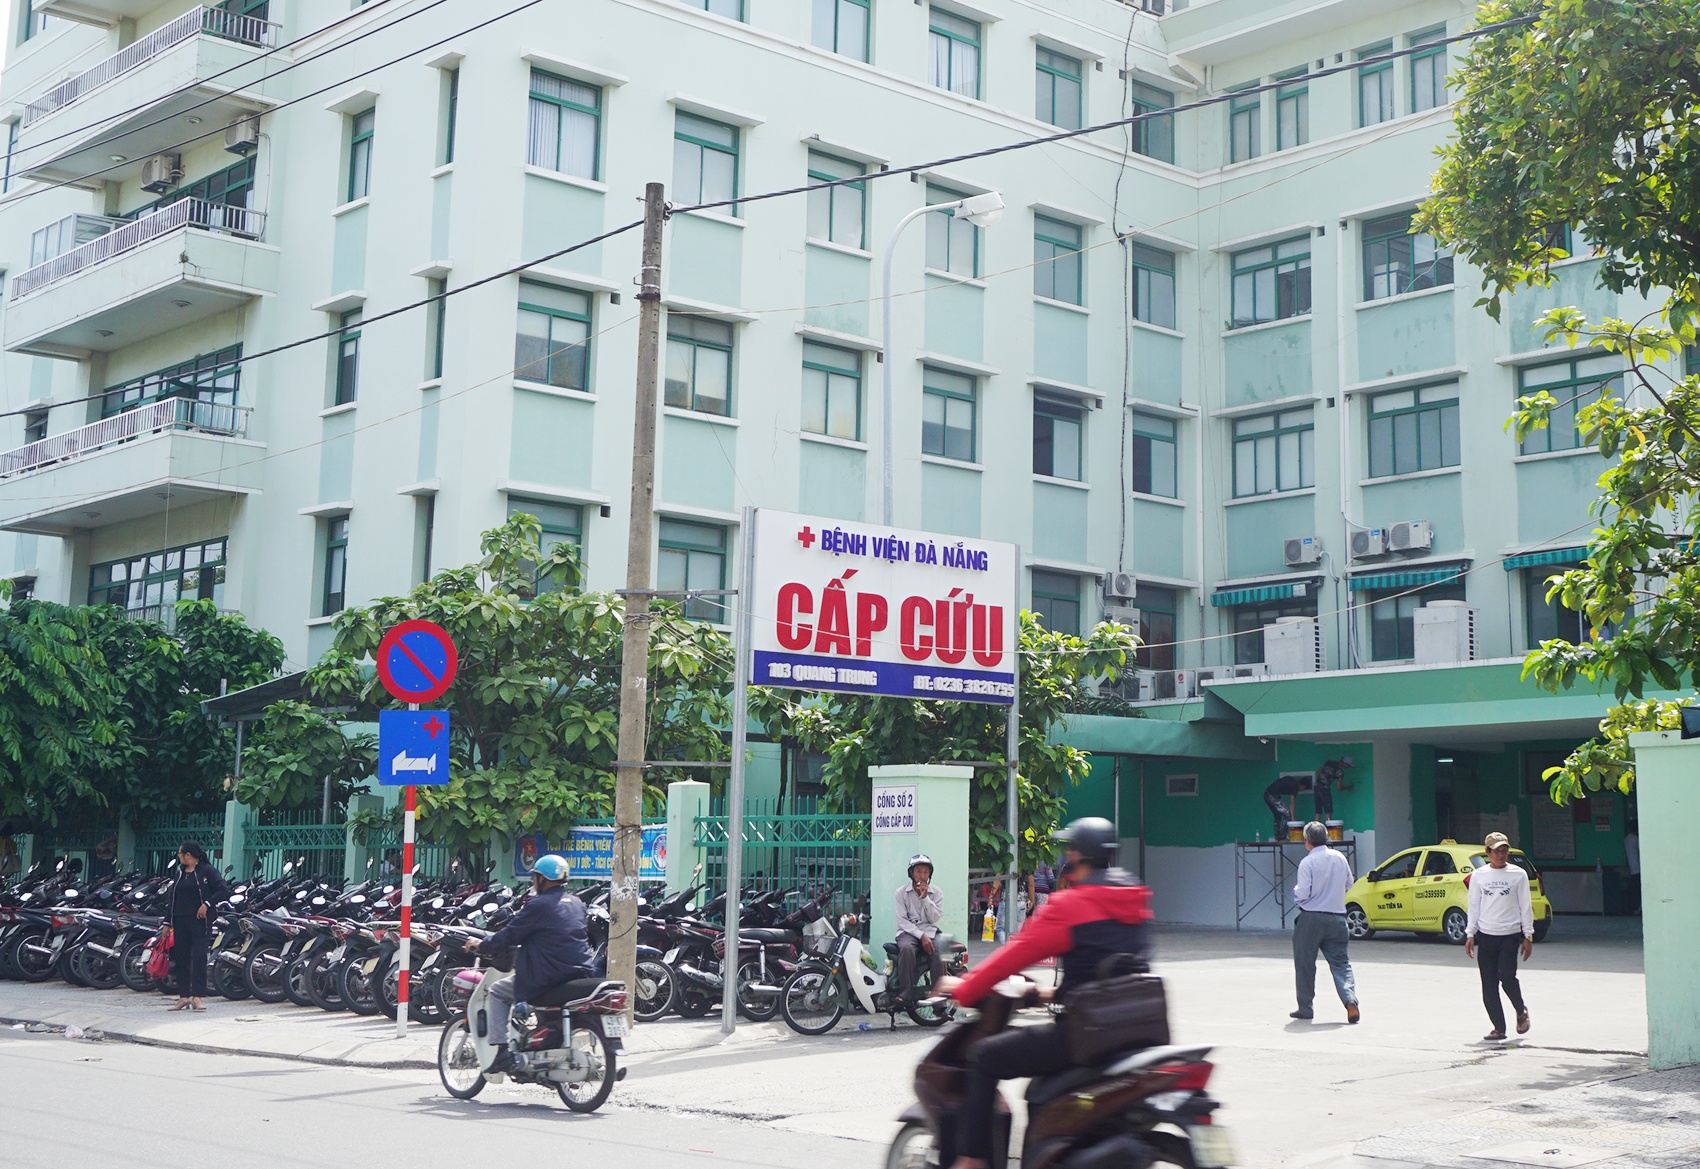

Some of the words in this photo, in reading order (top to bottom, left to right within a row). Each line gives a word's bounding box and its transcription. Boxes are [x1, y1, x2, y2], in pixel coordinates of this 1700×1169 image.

[821, 526, 867, 556] BỆNH
[872, 534, 909, 564] VIỆN
[914, 539, 937, 565] ĐÀ
[942, 541, 988, 571] NẴNG
[776, 568, 888, 657] CẤP
[899, 587, 1003, 667] CỨU
[768, 662, 791, 678] 103
[792, 664, 836, 682] QUANG
[836, 667, 877, 686] TRUNG
[897, 790, 907, 808] SỐ
[908, 793, 913, 808] 2
[891, 811, 902, 828] CẤP
[576, 837, 594, 853] BỆNH
[596, 837, 612, 853] VIỆN
